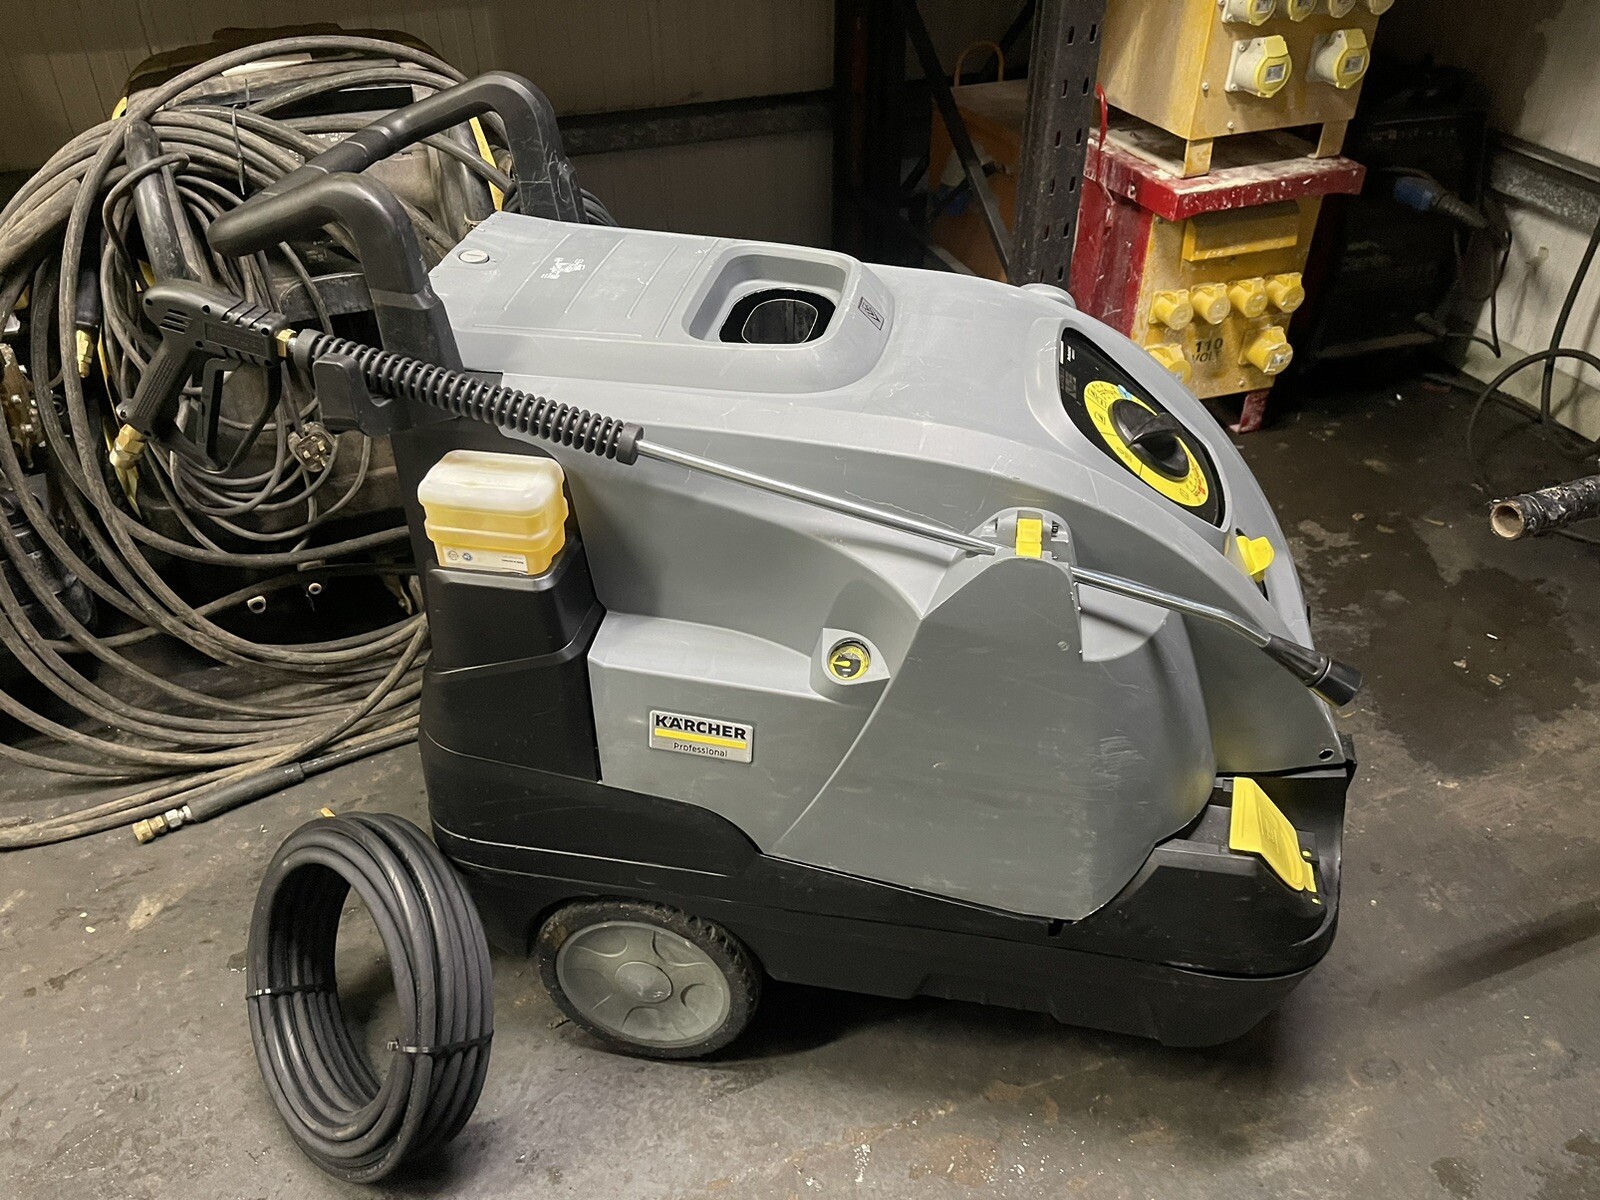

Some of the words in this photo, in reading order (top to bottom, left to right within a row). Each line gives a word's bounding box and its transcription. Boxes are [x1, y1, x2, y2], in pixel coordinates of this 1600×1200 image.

[1195, 338, 1223, 353] 110
[655, 714, 747, 740] KÄRCHER
[673, 742, 728, 758] Professional
